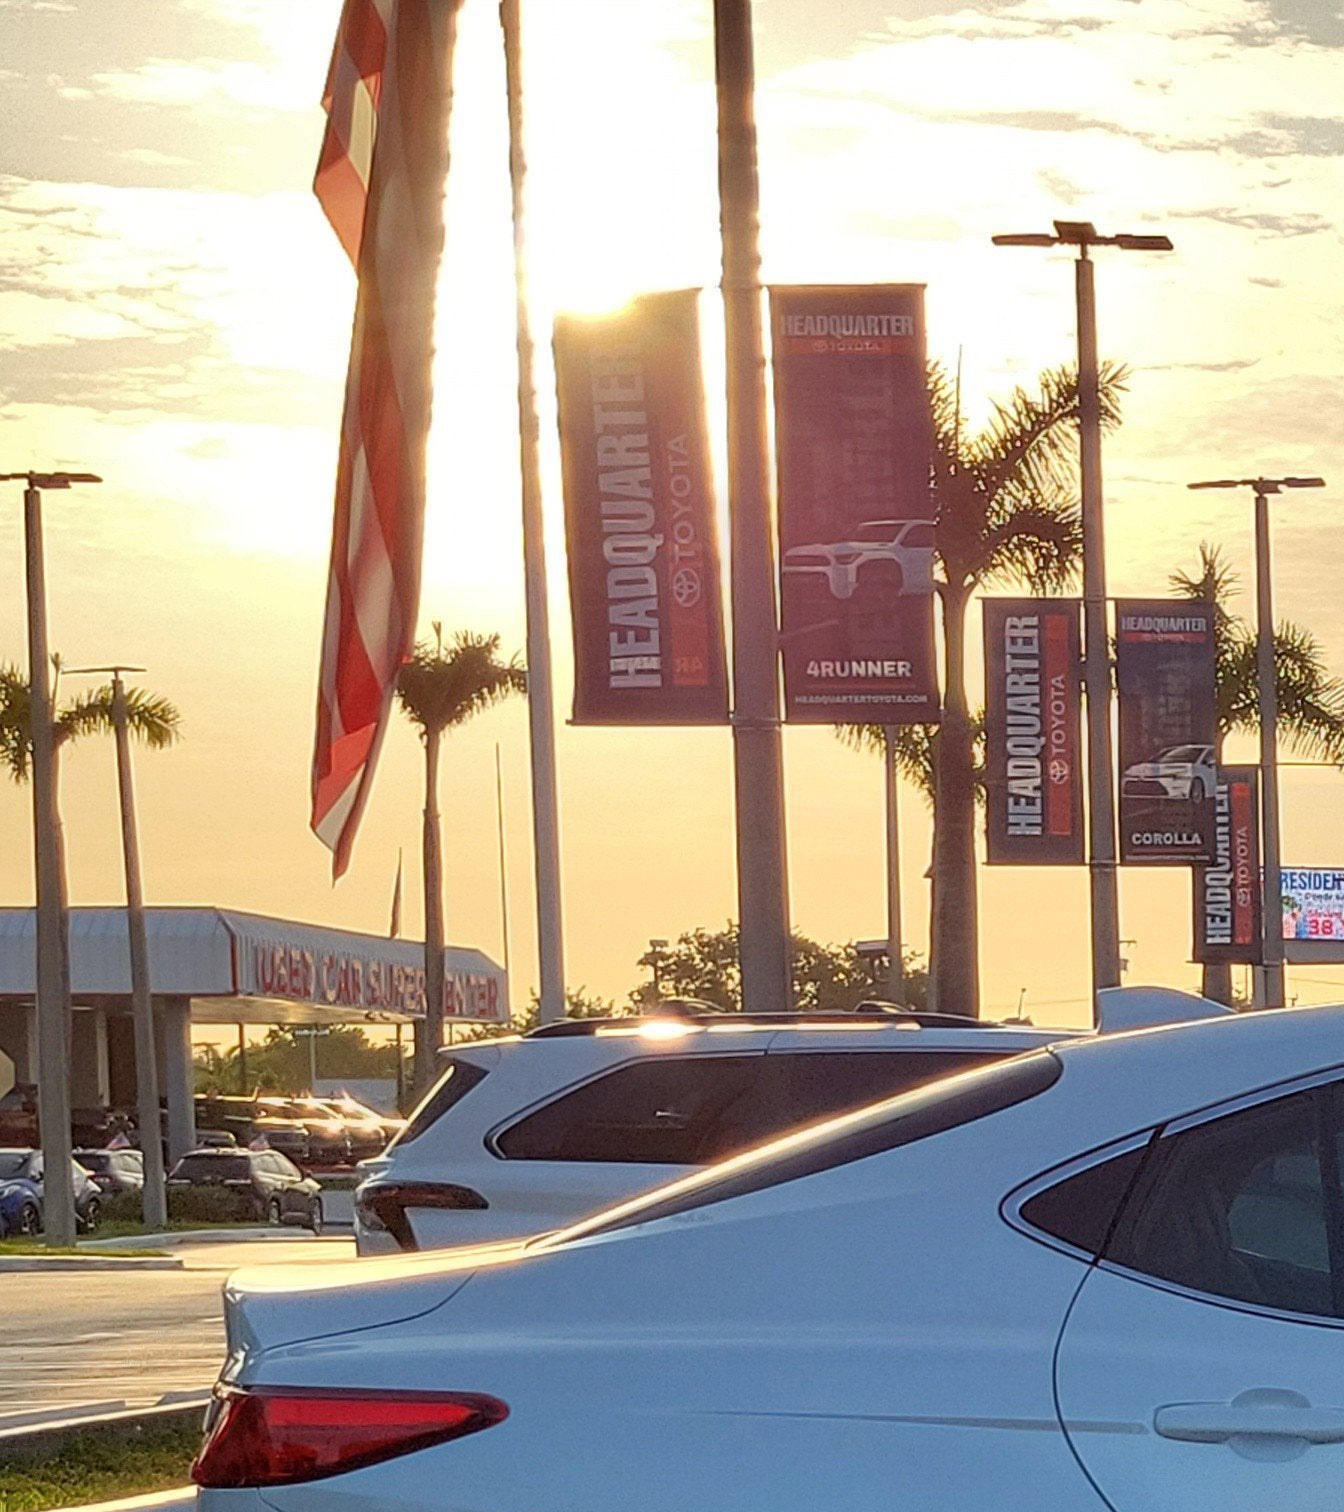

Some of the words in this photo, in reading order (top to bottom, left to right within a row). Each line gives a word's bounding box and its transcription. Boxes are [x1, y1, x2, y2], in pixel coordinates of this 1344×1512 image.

[780, 315, 914, 338] HEADQUARTER
[668, 435, 697, 563] TOYOTA
[1121, 616, 1207, 633] HEADQUARTER
[806, 660, 912, 678] 4RUNNER
[1005, 615, 1046, 836] HEADQUARTER
[1051, 675, 1067, 755] TOYOTA
[1131, 832, 1203, 845] COROLLA
[1236, 826, 1250, 890] TOYOTA
[1308, 919, 1333, 936] 38
[256, 945, 316, 999] USED
[443, 971, 498, 1017] ENTER
